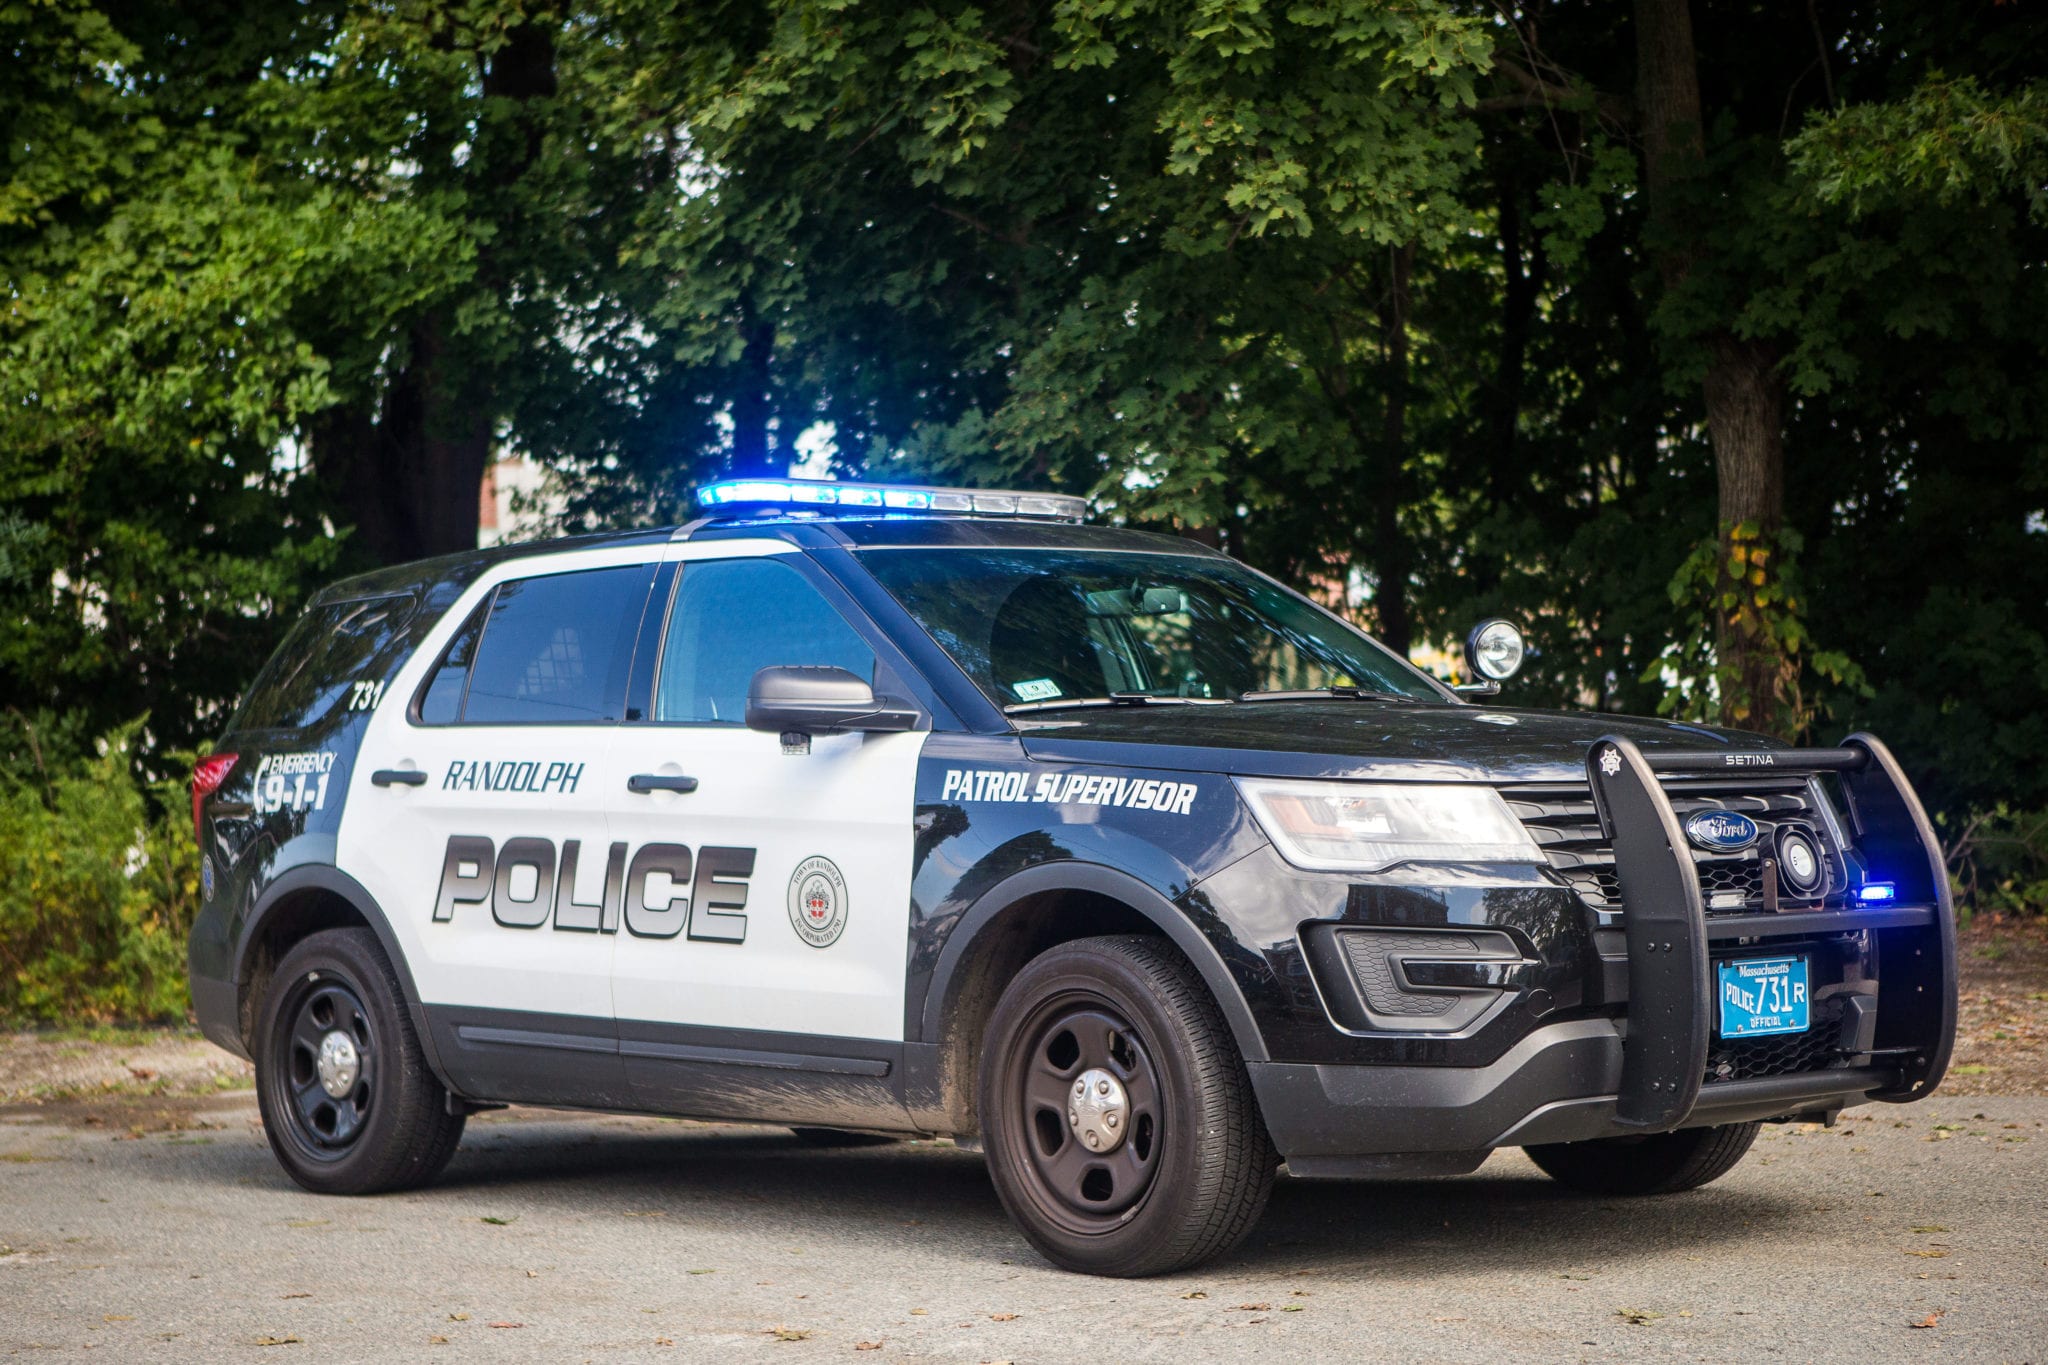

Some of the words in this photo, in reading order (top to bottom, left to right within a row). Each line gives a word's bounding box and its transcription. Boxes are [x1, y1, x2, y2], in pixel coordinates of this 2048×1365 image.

[349, 679, 385, 711] 731
[269, 752, 338, 775] EMERGENCY
[1725, 754, 1774, 766] SETINA
[442, 760, 585, 793] RANDOLPH
[265, 773, 330, 812] 9-1-1
[941, 769, 1029, 803] PATROL
[1033, 773, 1198, 815] SUPERVISOR
[1710, 817, 1749, 839] Ford
[794, 865, 808, 884] TOWN
[807, 860, 816, 869] OF
[816, 860, 842, 888] RANDOLPH
[432, 834, 757, 944] POLICE
[795, 918, 834, 943] INCORPORATED
[1740, 964, 1789, 978] Massachusetts
[1726, 983, 1754, 1014] POLICE
[1755, 976, 1792, 1014] 731
[1793, 982, 1805, 1003] R
[1750, 1016, 1781, 1029] OFFICIAL
